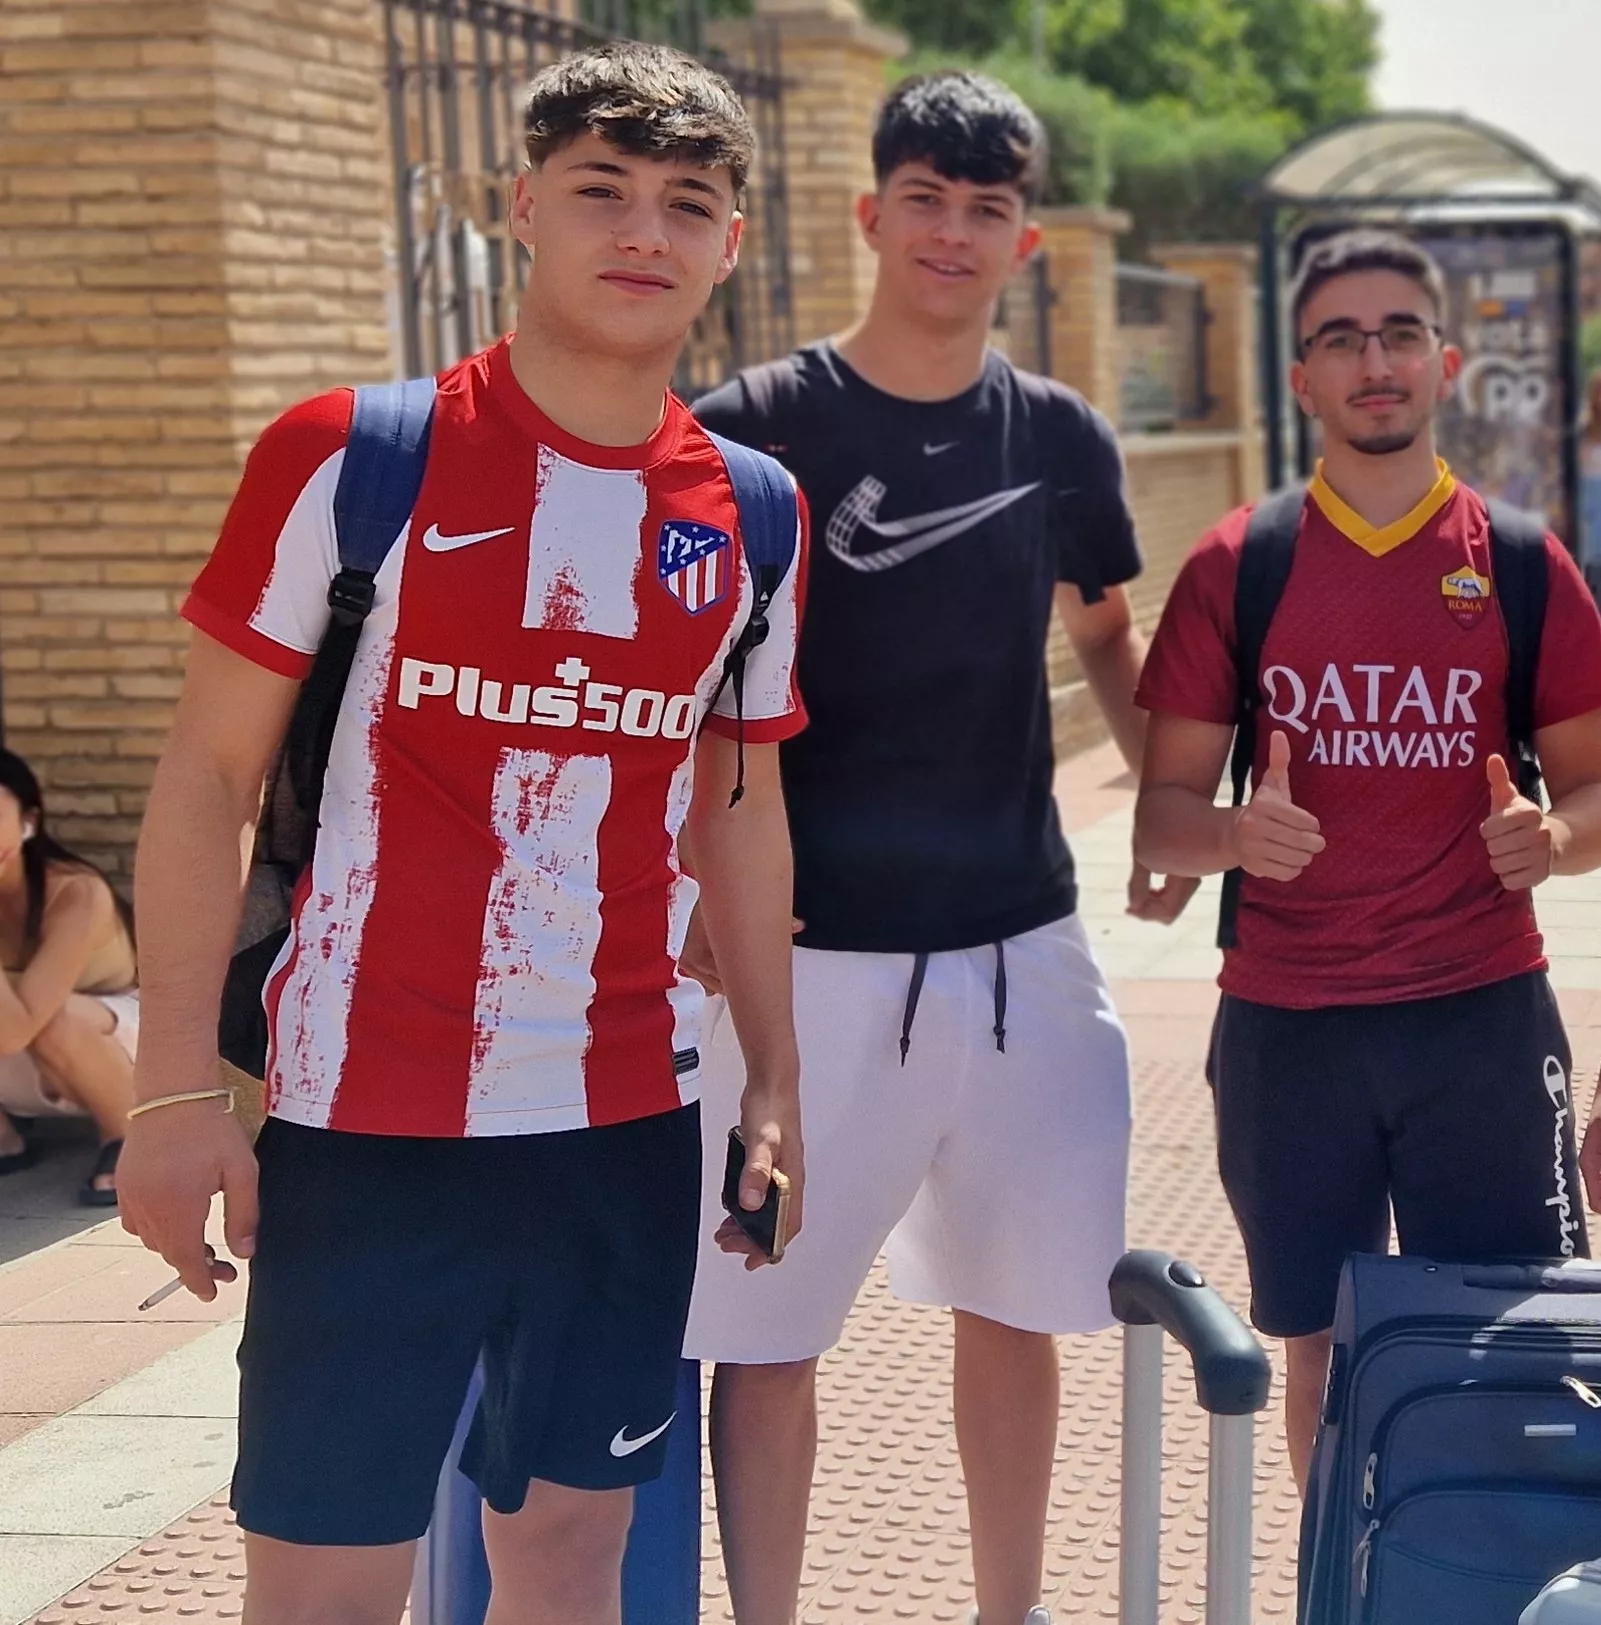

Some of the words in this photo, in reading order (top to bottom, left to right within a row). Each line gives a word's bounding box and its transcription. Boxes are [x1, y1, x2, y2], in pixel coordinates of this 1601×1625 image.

[1448, 599, 1483, 613] ROMA
[398, 656, 697, 740] Plus500
[1263, 663, 1483, 734] QATAR
[1308, 728, 1476, 768] AIRWAYS
[1543, 1055, 1579, 1258] Champio
